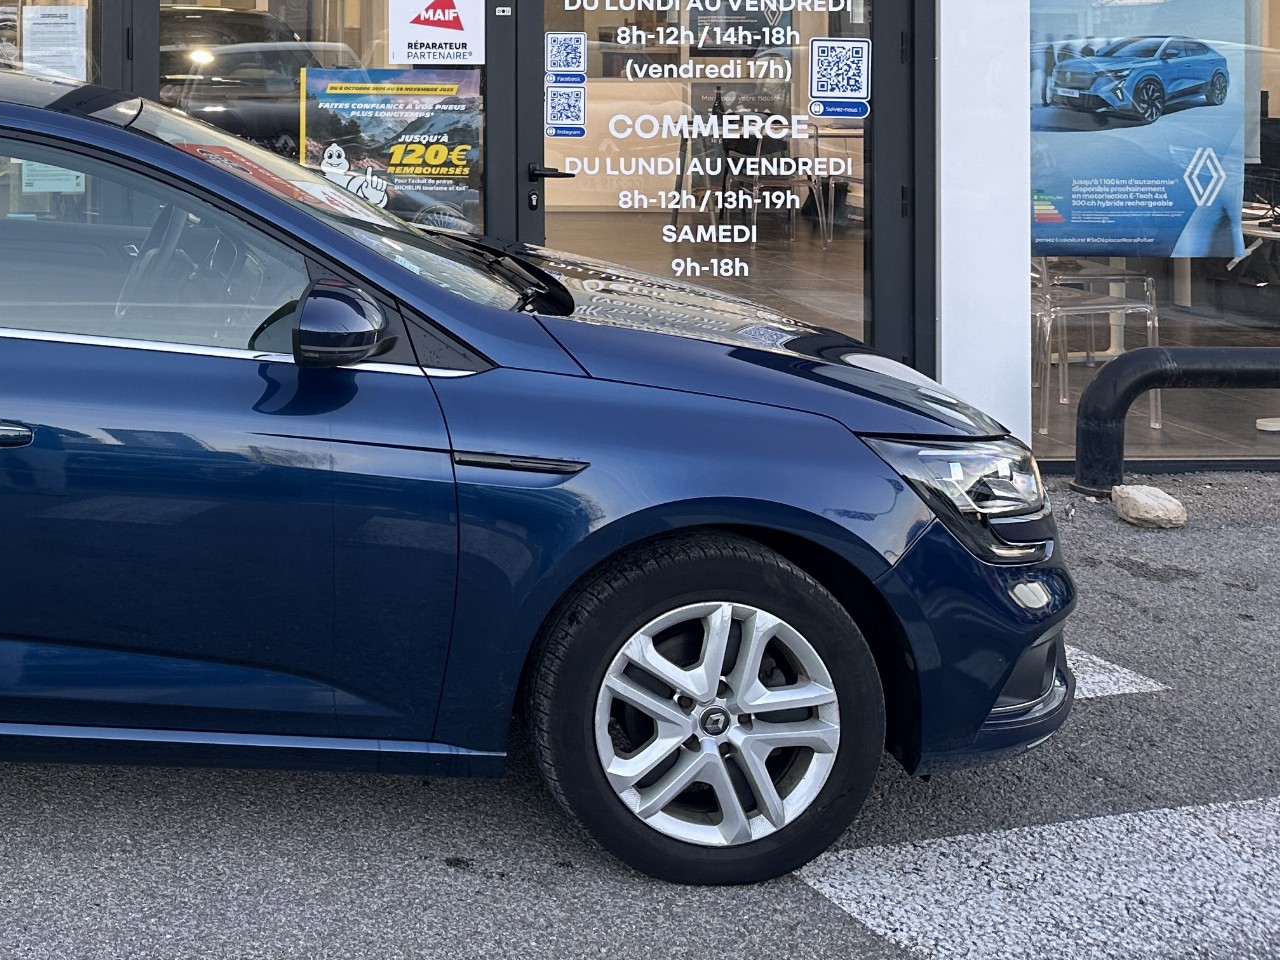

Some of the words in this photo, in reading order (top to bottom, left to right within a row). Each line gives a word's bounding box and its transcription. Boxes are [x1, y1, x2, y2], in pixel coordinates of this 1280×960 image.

[420, 8, 458, 21] MAIF
[407, 40, 468, 50] RÉPARATEUR
[625, 60, 741, 82] (vendredi
[747, 60, 793, 82] 17h)
[608, 114, 810, 139] COMMERCE
[398, 134, 449, 144] JUSQU'À
[388, 143, 472, 166] 120€
[386, 166, 470, 175] REMBOURSÉS
[565, 157, 601, 176] DU
[606, 157, 681, 176] LUNDI
[686, 157, 722, 176] AU
[726, 158, 853, 176] VENDREDI
[1097, 200, 1124, 208] hybride
[1124, 200, 1174, 208] rechargeable
[662, 224, 757, 243] SAMEDI
[671, 258, 749, 277] 9h-18h
